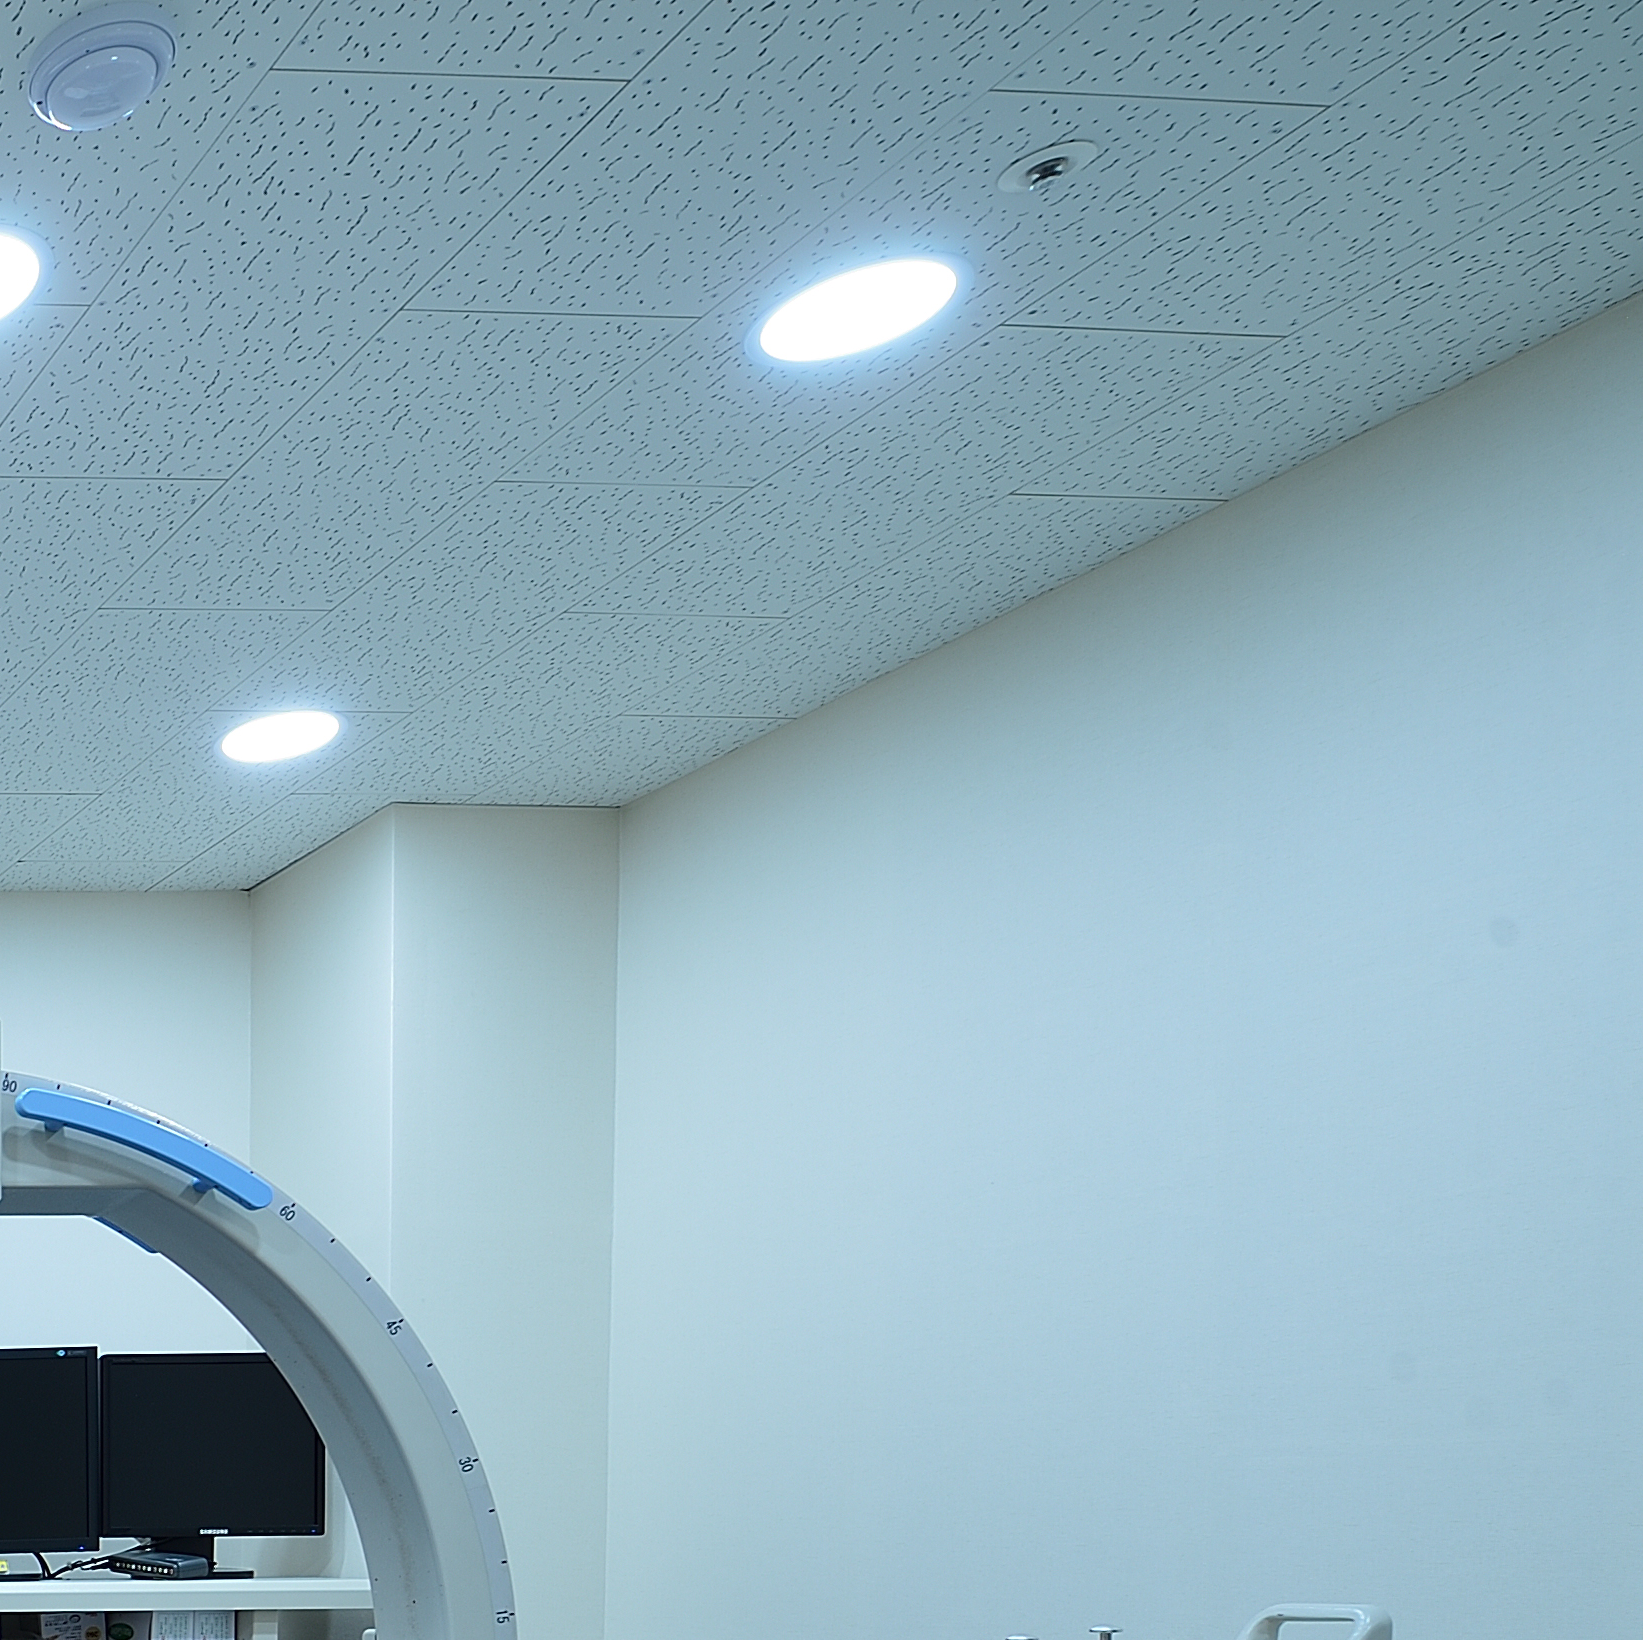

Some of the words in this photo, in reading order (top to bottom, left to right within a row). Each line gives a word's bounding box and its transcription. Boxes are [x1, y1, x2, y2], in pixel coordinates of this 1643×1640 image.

[2, 1080, 17, 1092] 90
[279, 1205, 295, 1221] 60
[386, 1319, 402, 1336] 45
[458, 1456, 474, 1473] 30
[495, 1609, 510, 1624] 15
